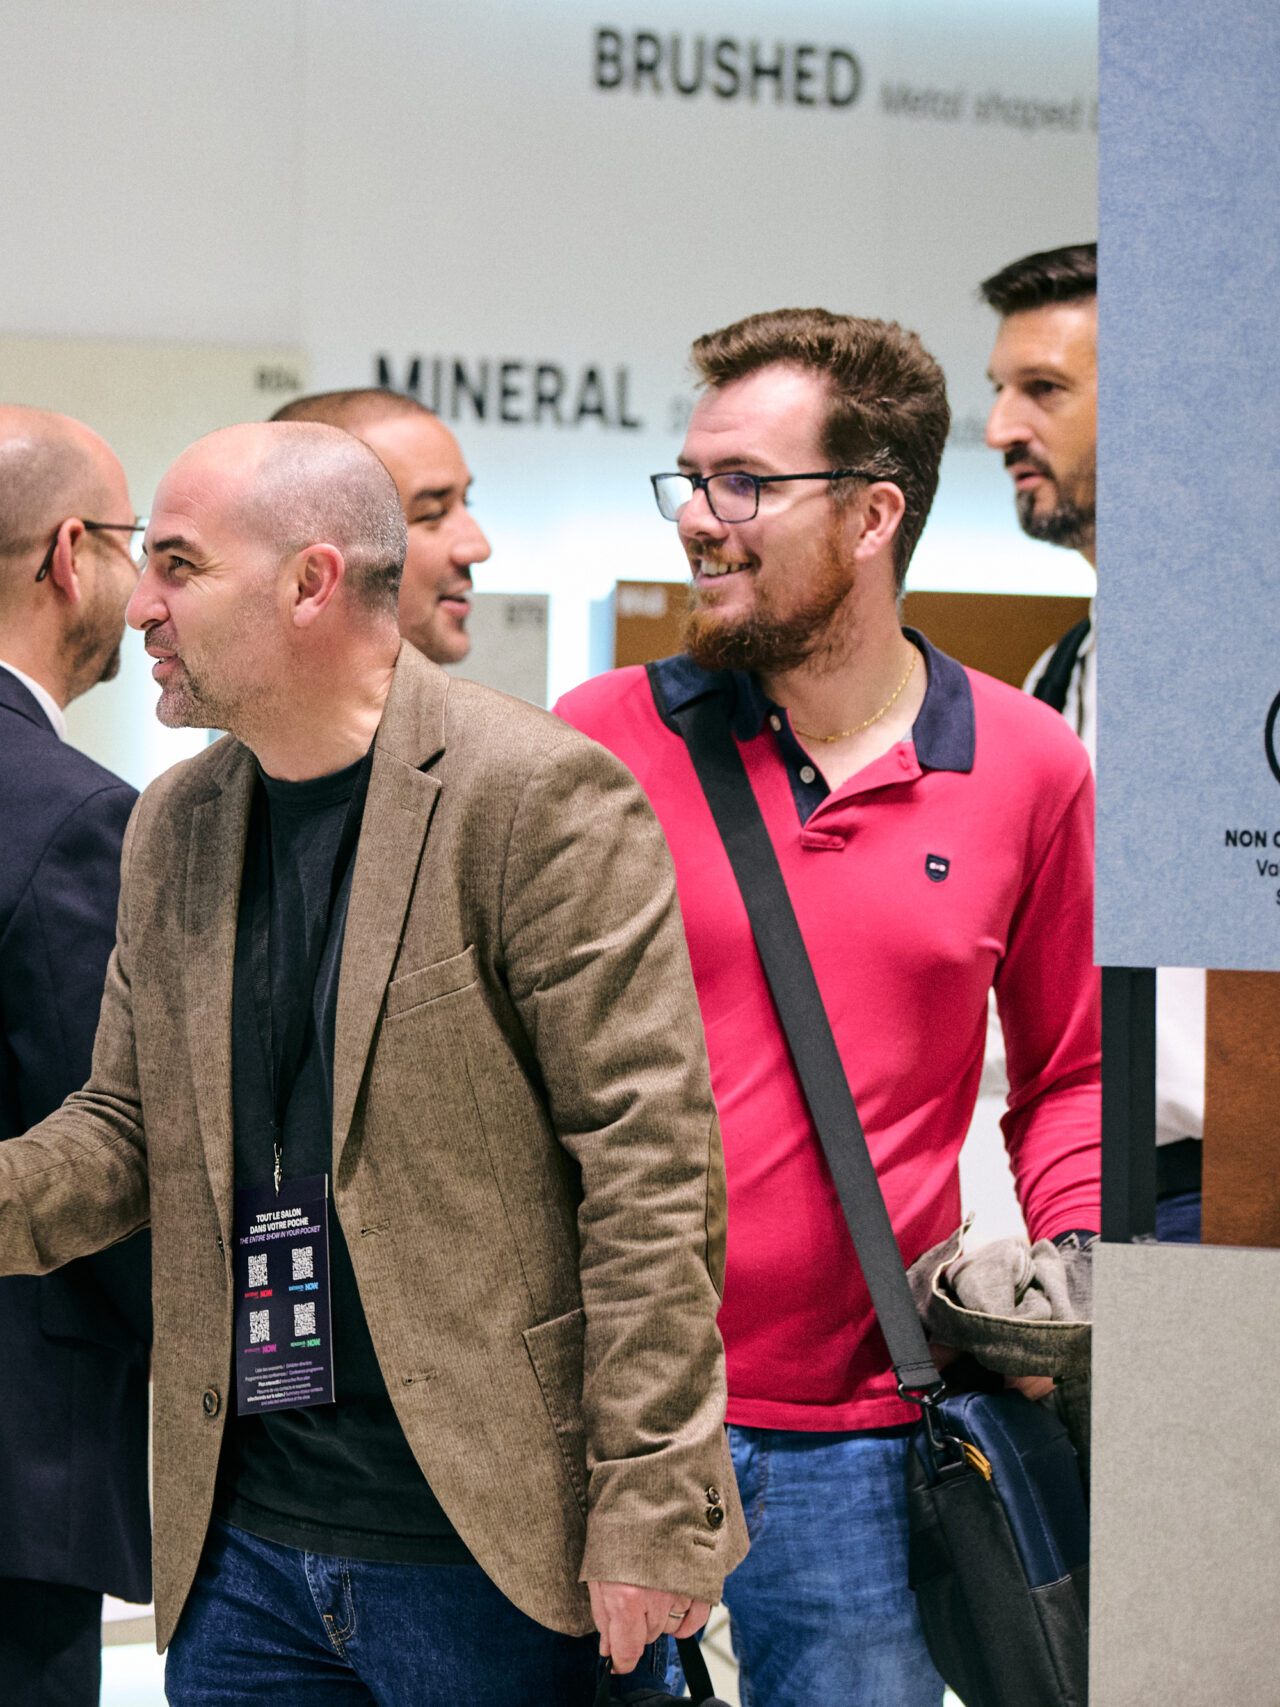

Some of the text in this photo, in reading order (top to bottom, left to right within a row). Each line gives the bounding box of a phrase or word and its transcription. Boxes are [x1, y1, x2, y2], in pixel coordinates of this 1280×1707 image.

[596, 28, 861, 108] BRUSHED
[376, 352, 641, 428] MINERAL
[1225, 830, 1267, 848] NON
[256, 1208, 302, 1223] TOUT LE SALON
[249, 1234, 265, 1244] ENTIRE
[266, 1232, 280, 1240] SHOW
[286, 1228, 300, 1237] YOUR
[300, 1225, 321, 1235] POCKET
[250, 1217, 309, 1234] DANS VOTRE POCHE
